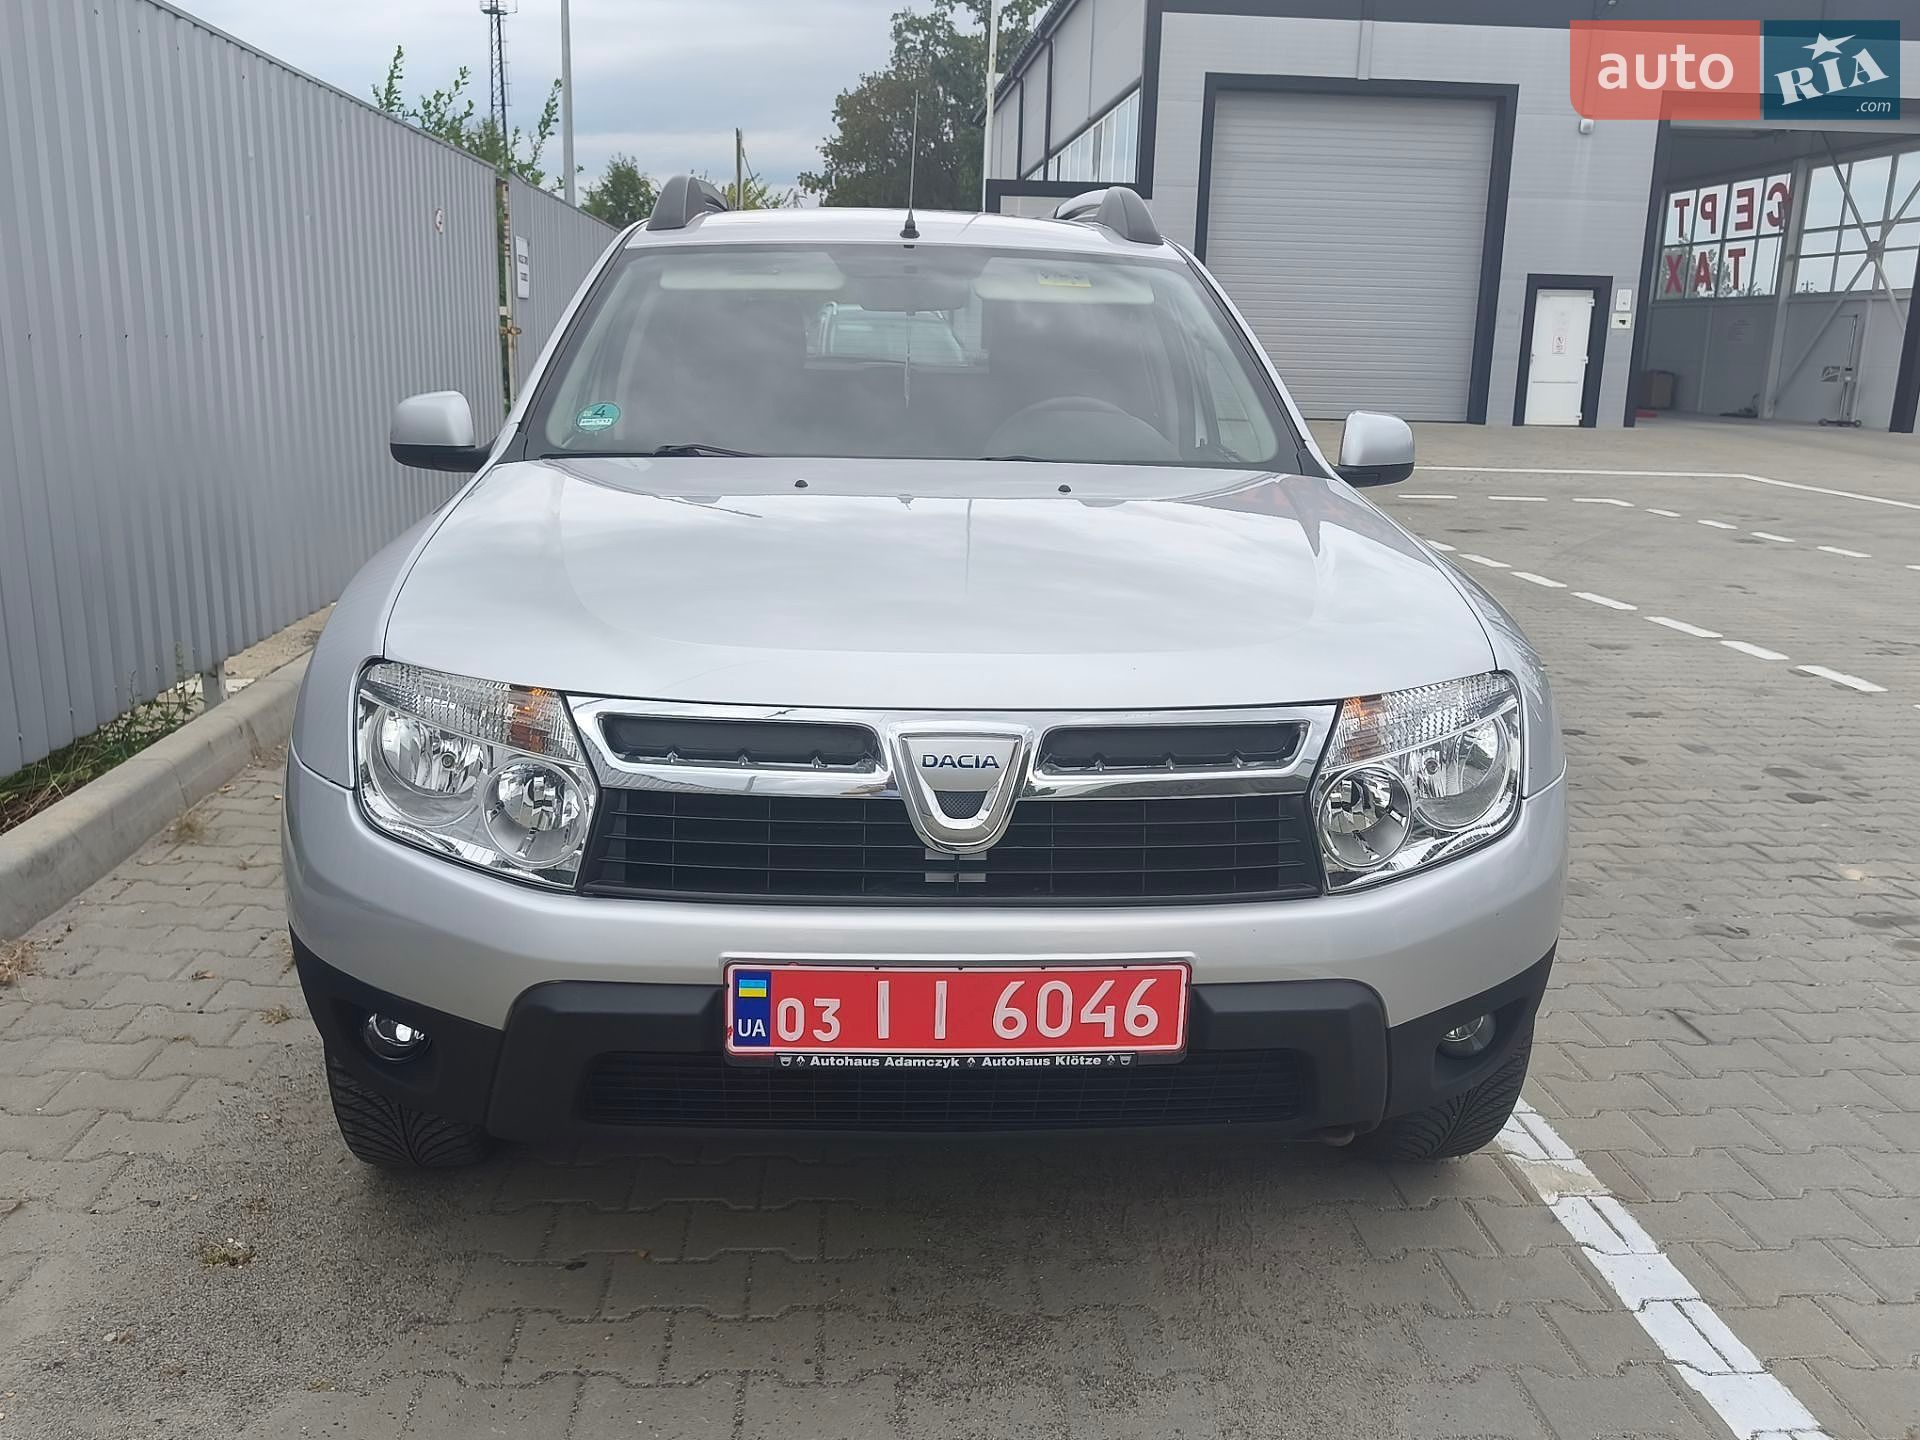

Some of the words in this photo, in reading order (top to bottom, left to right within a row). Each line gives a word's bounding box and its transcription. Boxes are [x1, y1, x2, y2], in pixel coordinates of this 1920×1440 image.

[593, 405, 606, 418] 4
[922, 754, 1000, 769] DACIA
[776, 997, 841, 1042] 03
[992, 978, 1159, 1040] 6046
[737, 1018, 767, 1038] UA
[810, 1056, 880, 1067] Autohaus
[884, 1056, 960, 1069] Adamczyk
[982, 1056, 1051, 1067] Autohaus
[1055, 1055, 1102, 1066] Klötze
